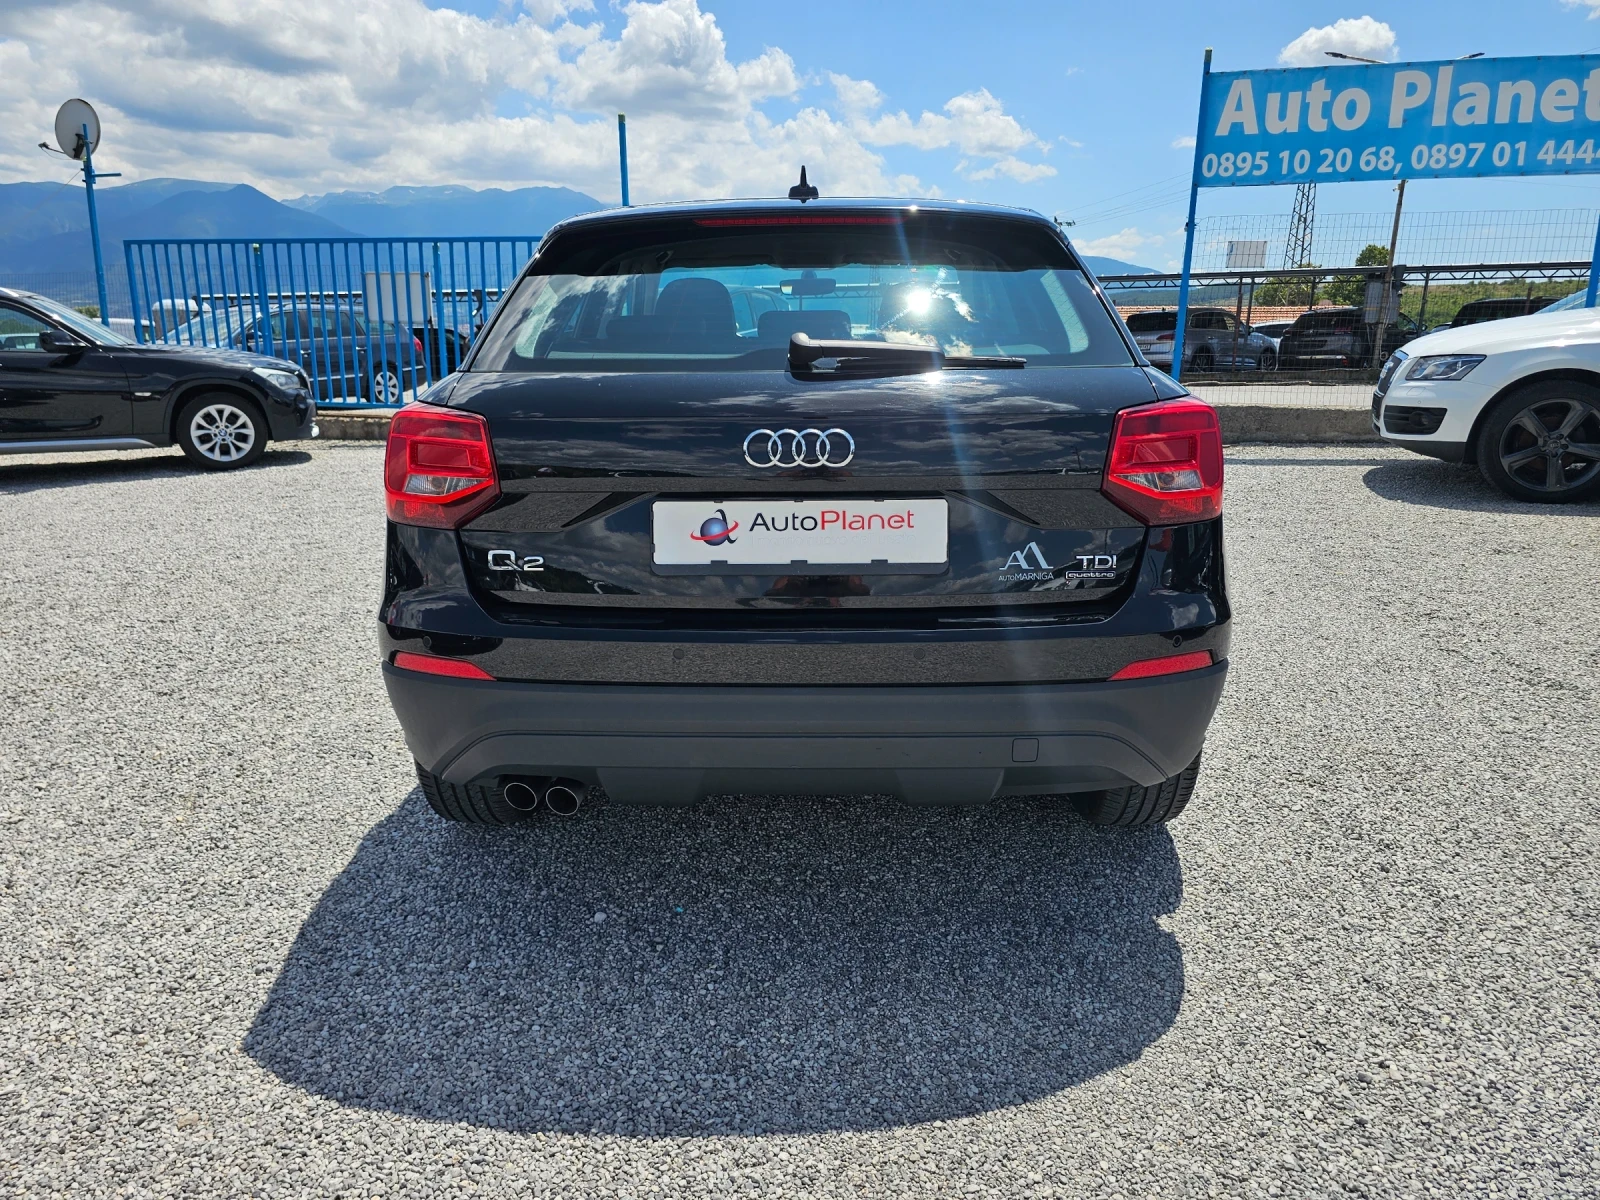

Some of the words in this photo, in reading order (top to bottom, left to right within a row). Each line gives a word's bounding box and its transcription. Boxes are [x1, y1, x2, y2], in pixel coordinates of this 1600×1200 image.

[1215, 77, 1371, 136] Auto
[1388, 65, 1600, 129] Planet
[1202, 151, 1269, 178] 0895
[1279, 149, 1311, 175] 10
[1317, 147, 1353, 173] 20
[1359, 146, 1403, 175] 68,
[1411, 142, 1486, 170] 0897
[1492, 141, 1527, 167] 01
[1537, 139, 1600, 165] 444
[749, 510, 915, 532] AutoPlanet
[487, 549, 545, 572] Q2
[1075, 554, 1117, 569] TDI
[1067, 571, 1115, 579] quattro
